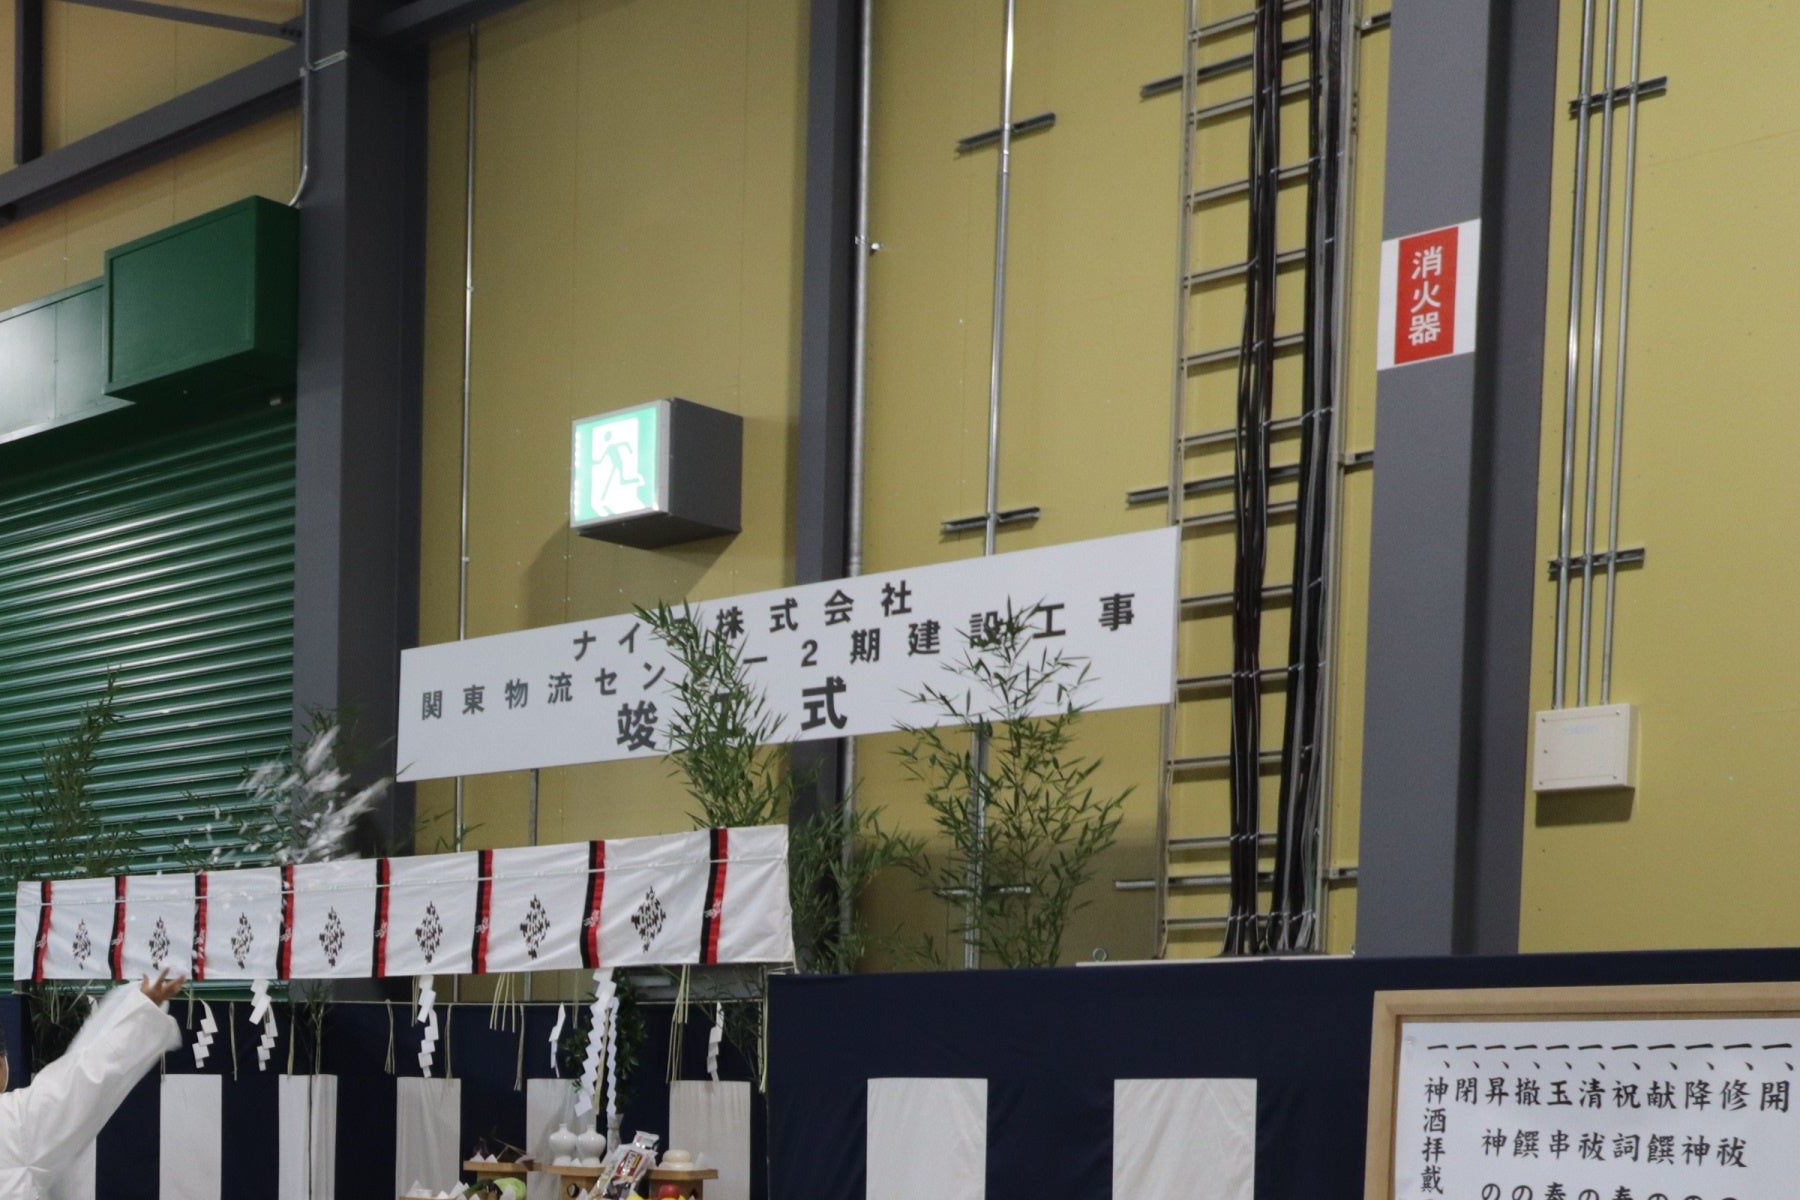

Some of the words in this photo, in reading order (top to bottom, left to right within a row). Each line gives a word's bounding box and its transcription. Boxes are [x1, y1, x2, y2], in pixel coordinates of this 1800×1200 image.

[1408, 245, 1443, 346] 消火器
[421, 592, 1135, 720] 関東物流センー2期建設工事
[572, 579, 912, 662] ナイ株式会社
